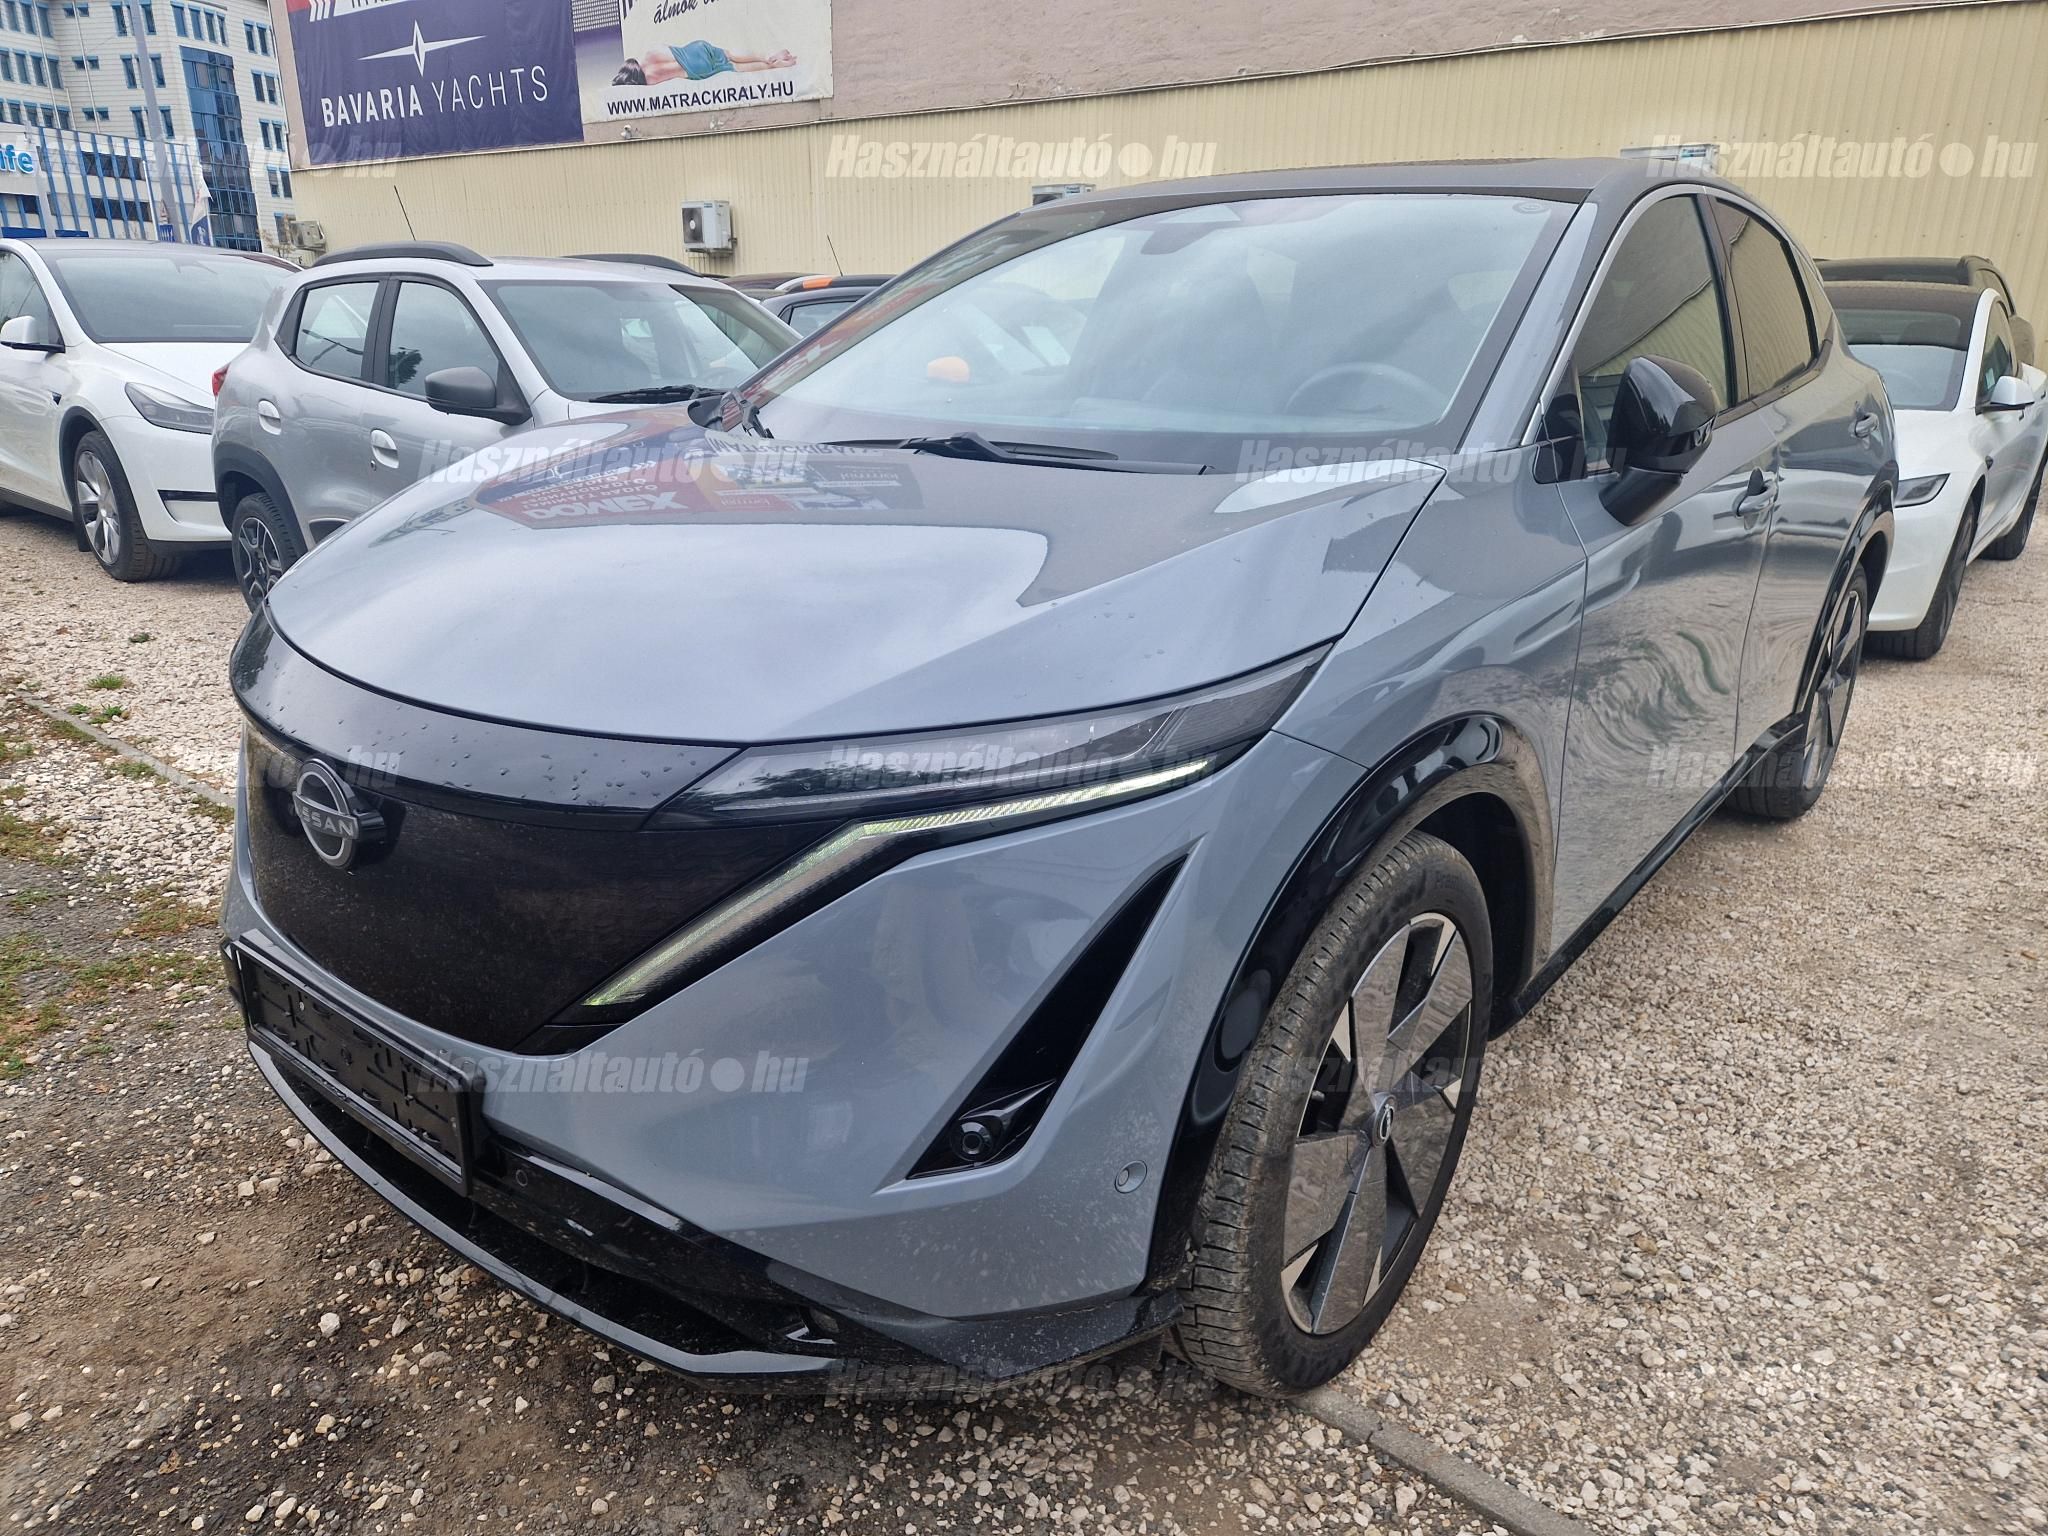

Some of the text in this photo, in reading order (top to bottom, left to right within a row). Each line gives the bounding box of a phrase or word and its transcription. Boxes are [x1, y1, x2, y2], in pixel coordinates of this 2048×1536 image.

[320, 65, 549, 128] BAVARIA YACHTS
[607, 81, 794, 115] WWW.MATRACKIRALY.HU
